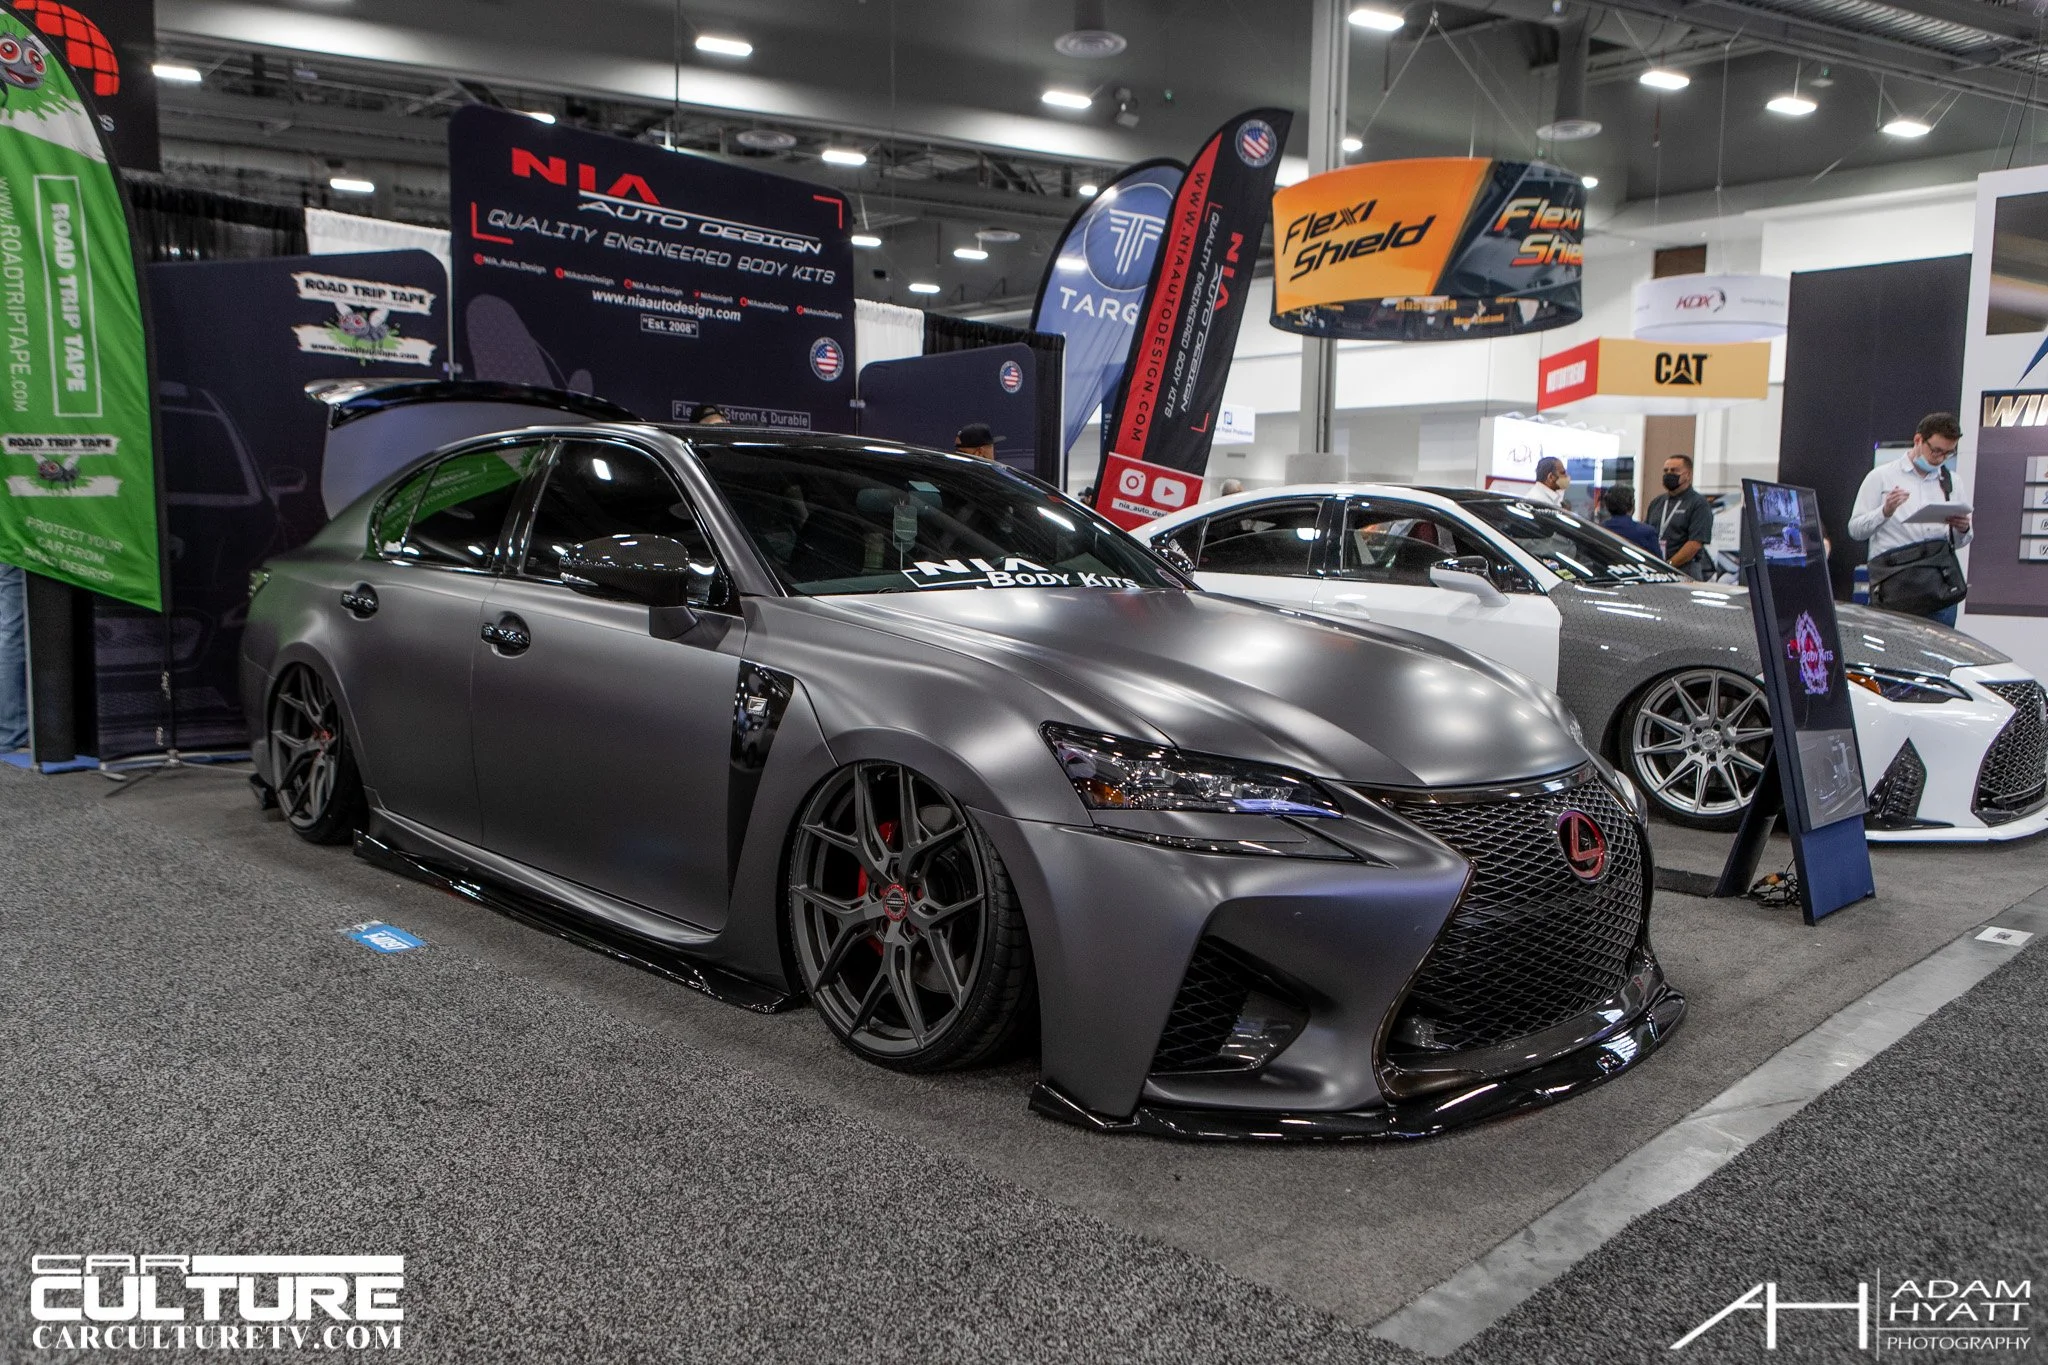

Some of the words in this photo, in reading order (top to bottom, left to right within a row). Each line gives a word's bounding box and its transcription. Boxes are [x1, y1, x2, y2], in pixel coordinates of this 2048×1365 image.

[512, 147, 661, 206] NIA
[51, 203, 77, 270] ROAD
[487, 208, 598, 243] QUALITY
[603, 231, 732, 268] ENGINEERED
[737, 255, 788, 277] BODY
[792, 264, 836, 285] KITS
[577, 201, 688, 230] AUTO
[699, 222, 822, 254] DESIGN
[1200, 212, 1220, 272] QUALITY
[304, 278, 348, 294] ROAD
[352, 284, 386, 298] TRIP
[389, 290, 427, 305] TAPE
[1201, 262, 1220, 327] AUTO
[1214, 231, 1244, 311] NIA
[58, 274, 82, 330] TRIP
[592, 289, 742, 322] www.niaautodesign.com
[1131, 171, 1206, 442] WWW.NIAAUTODESIGN.COM
[1181, 270, 1206, 349] ENGINEERED
[64, 333, 87, 393] TAPE
[1172, 349, 1186, 385] BODY
[1655, 351, 1708, 385] CAT
[770, 412, 808, 427] Durable
[1164, 382, 1179, 419] KITS
[8, 437, 44, 448] ROAD
[47, 438, 78, 448] TRIP
[80, 438, 111, 448] TAPE
[25, 516, 85, 543] PROTECT
[87, 535, 124, 553] YOUR
[65, 543, 105, 565] FROM
[913, 558, 1049, 576] NIA
